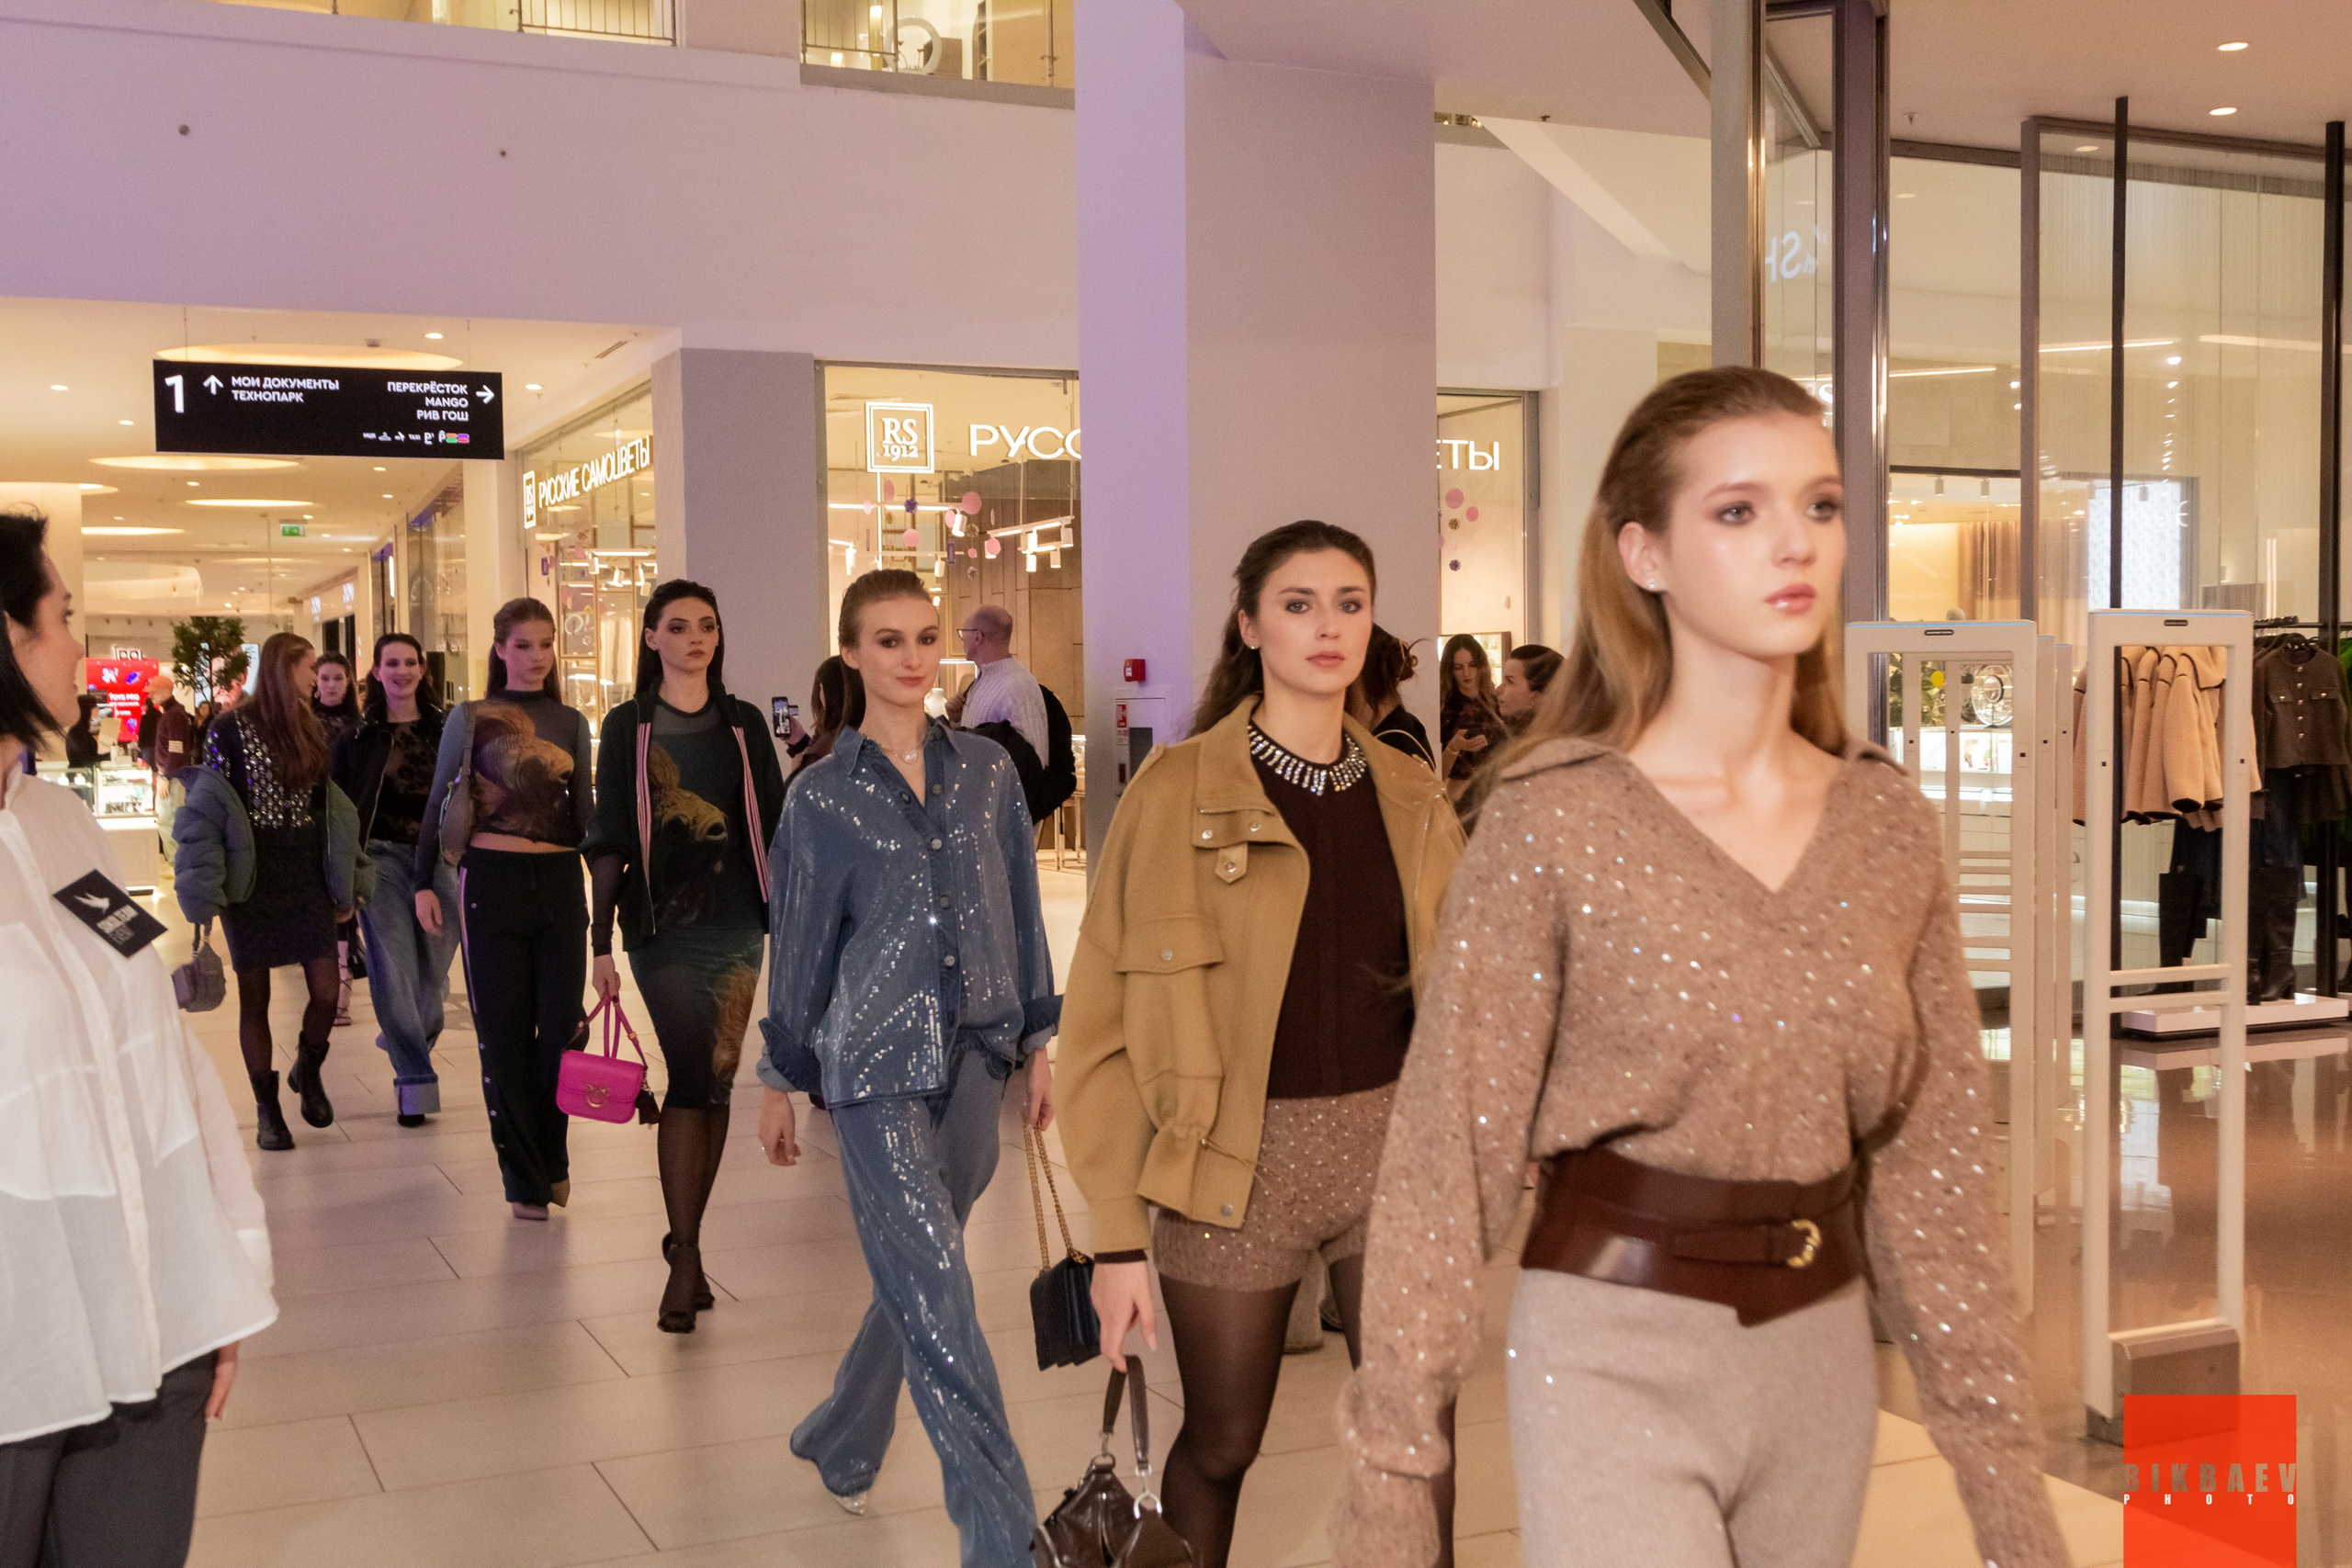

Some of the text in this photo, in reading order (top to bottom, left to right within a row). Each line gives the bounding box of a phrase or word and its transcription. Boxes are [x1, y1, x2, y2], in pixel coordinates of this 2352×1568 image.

[231, 376, 340, 390] МОИ ДОКУМЕНТЫ
[387, 380, 469, 395] ПЕРЕКРЁСТОК
[164, 374, 185, 413] 1
[231, 389, 304, 402] ТЕХНОПАРК
[424, 396, 469, 408] MANGO
[416, 410, 469, 422] РИВ ГОШ
[882, 417, 919, 446] RS
[882, 444, 919, 461] 1912
[1436, 439, 1499, 470] ТЫ
[538, 434, 650, 509] РУССКИЕ САМОЦВЕТЫ
